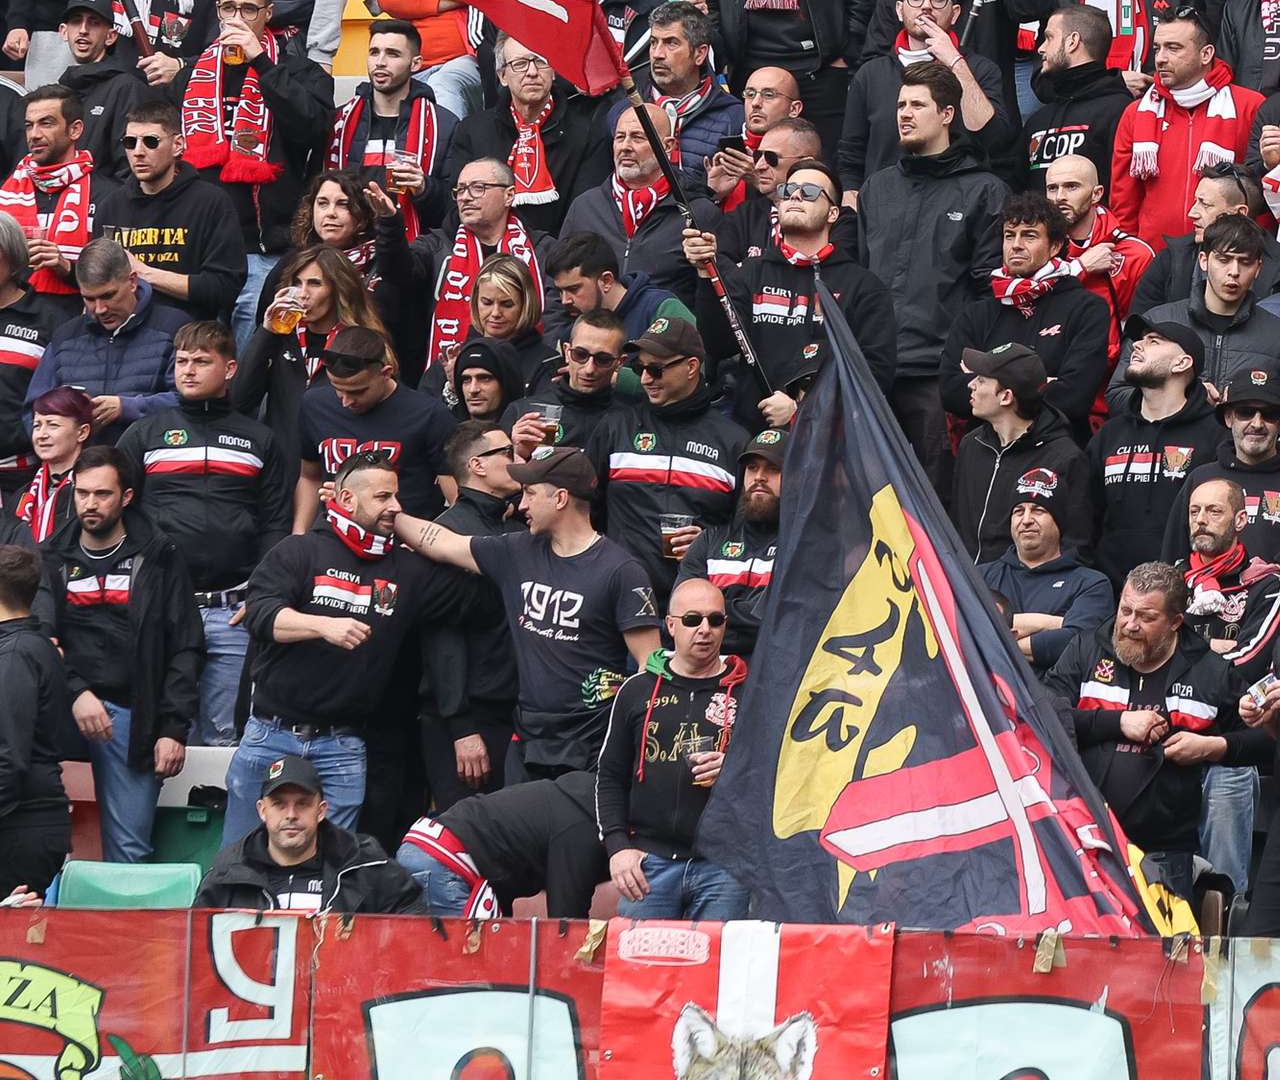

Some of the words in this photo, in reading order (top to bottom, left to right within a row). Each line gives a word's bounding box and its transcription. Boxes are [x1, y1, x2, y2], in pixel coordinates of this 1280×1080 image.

[608, 14, 625, 27] MON
[1043, 132, 1087, 162] CDP
[5, 323, 39, 341] MONZA
[217, 434, 252, 450] MONZA
[685, 440, 720, 461] MONZA
[326, 567, 362, 585] CURVA
[520, 580, 585, 630] 1912
